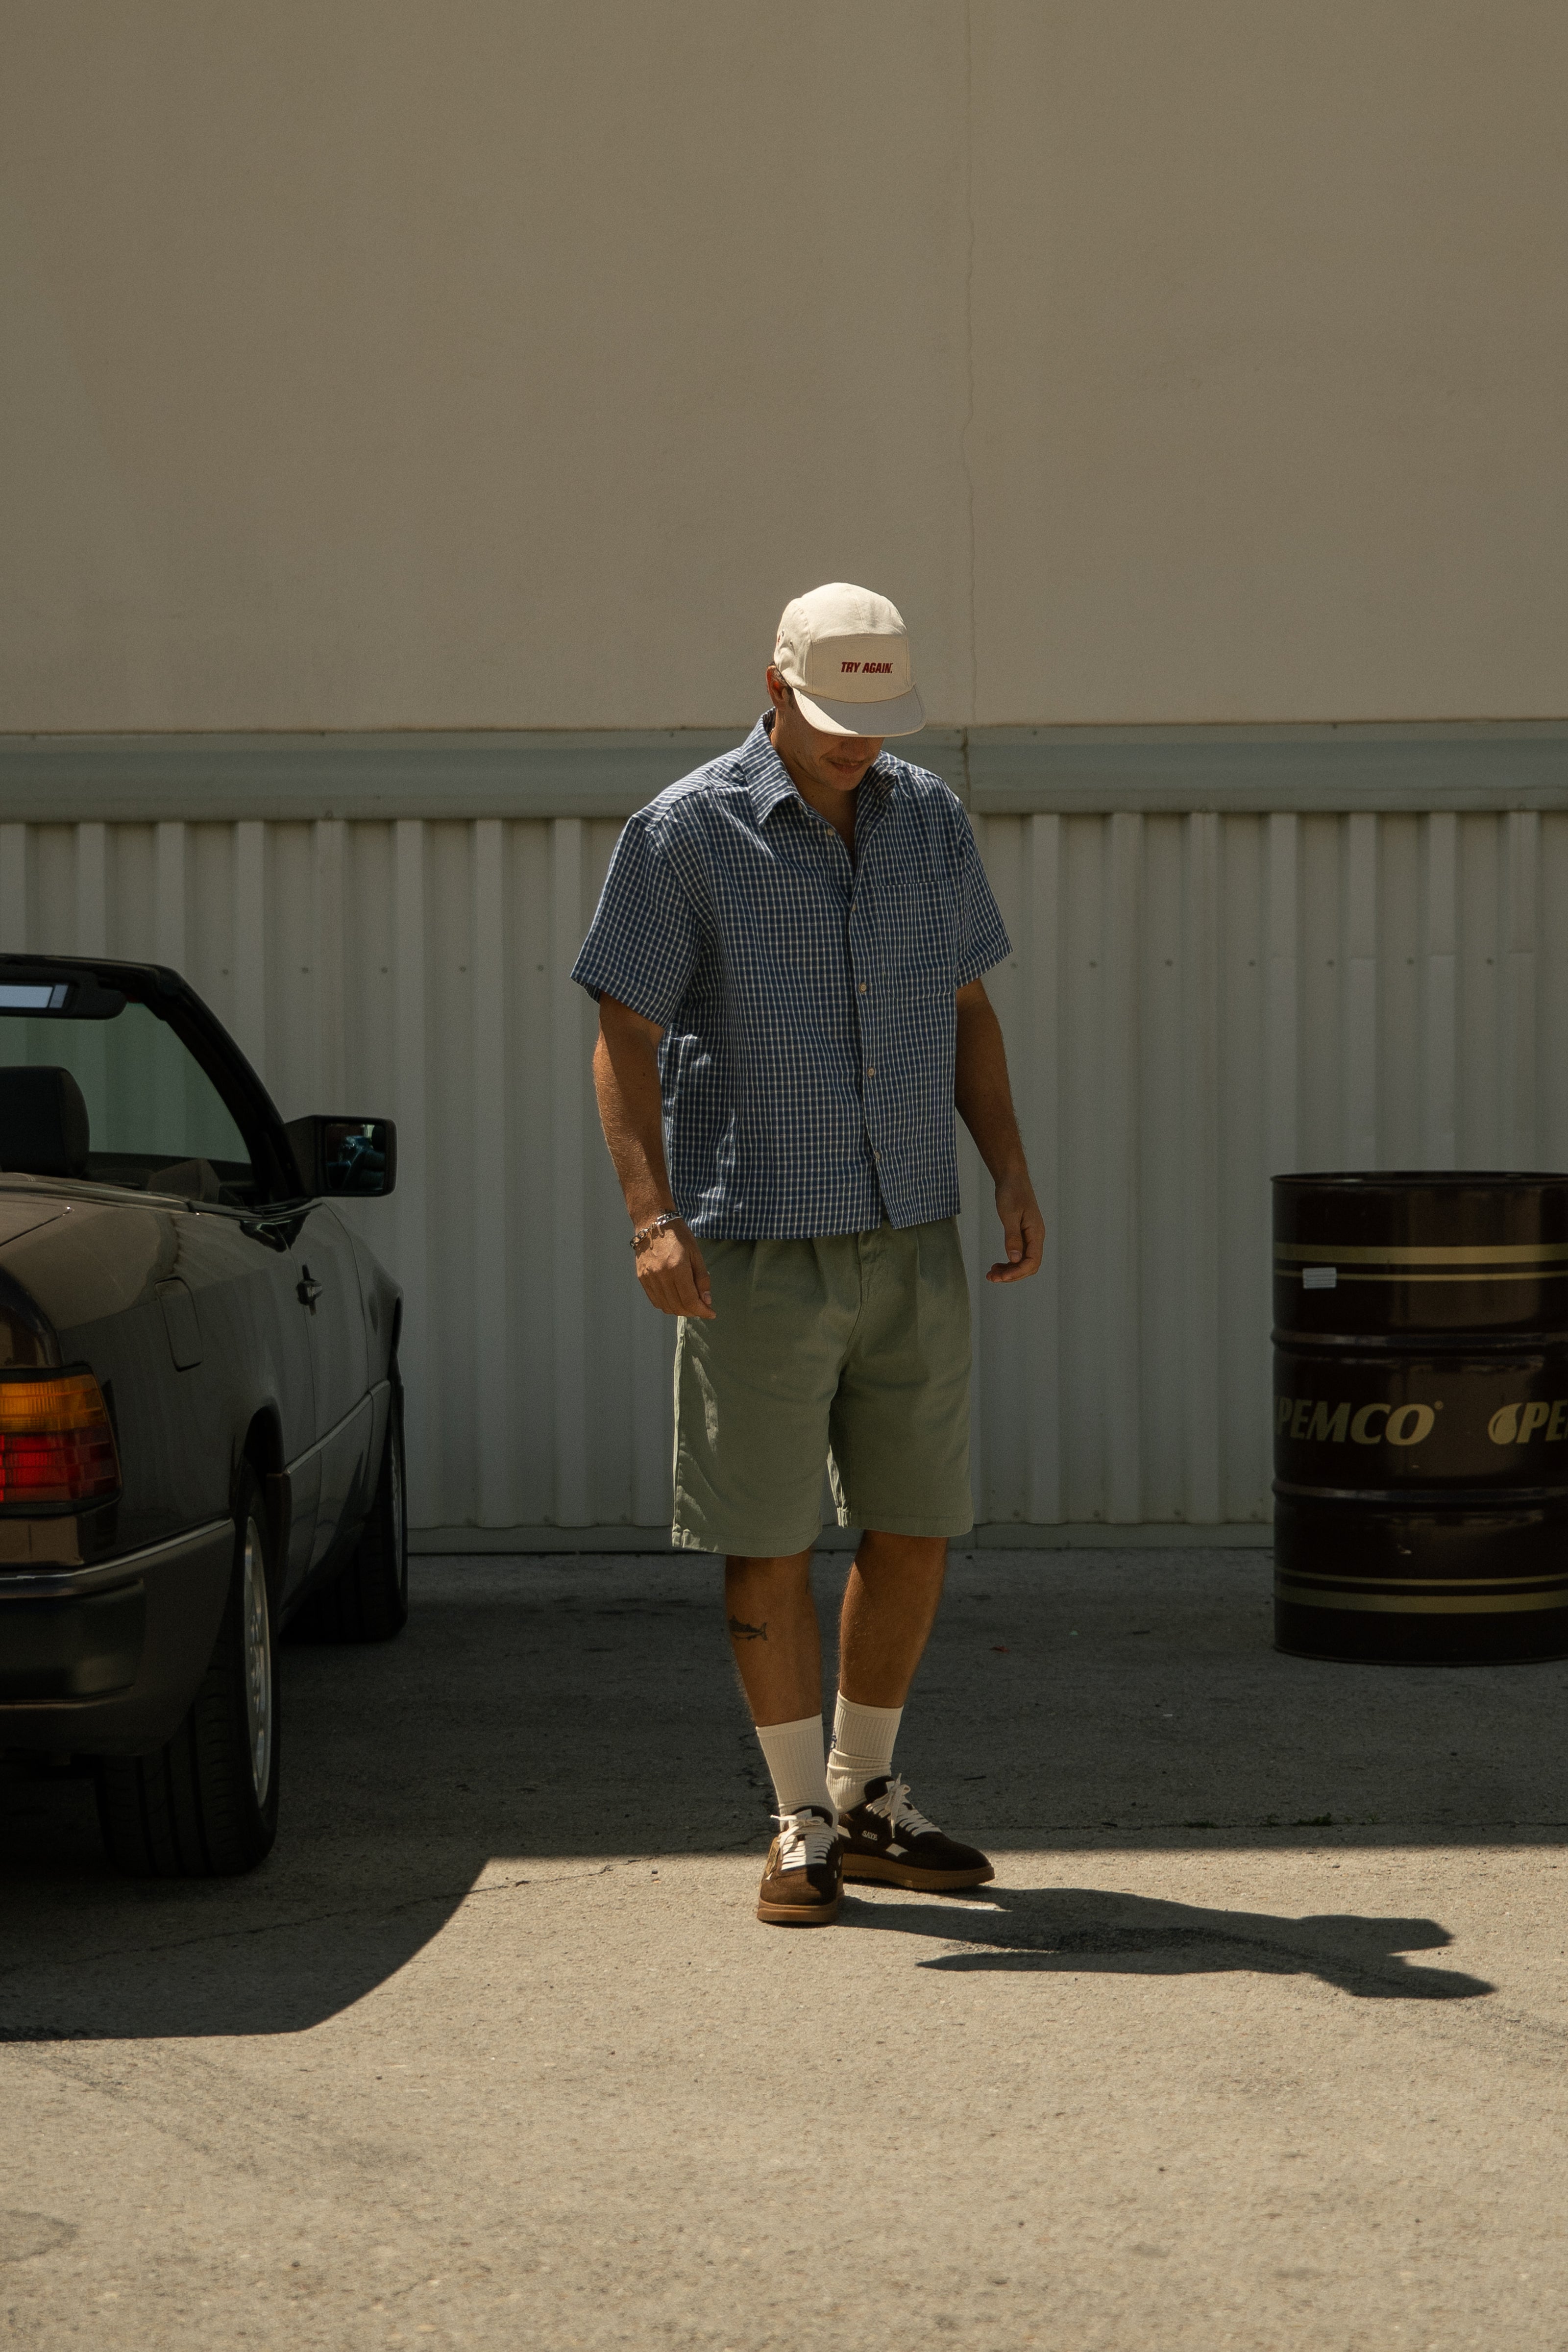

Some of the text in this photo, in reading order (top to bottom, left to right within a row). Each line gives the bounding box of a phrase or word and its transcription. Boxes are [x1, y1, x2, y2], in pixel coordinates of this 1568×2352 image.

[841, 662, 861, 673] TRY
[1516, 1399, 1568, 1444] PE
[862, 1830, 878, 1841] SAYE
